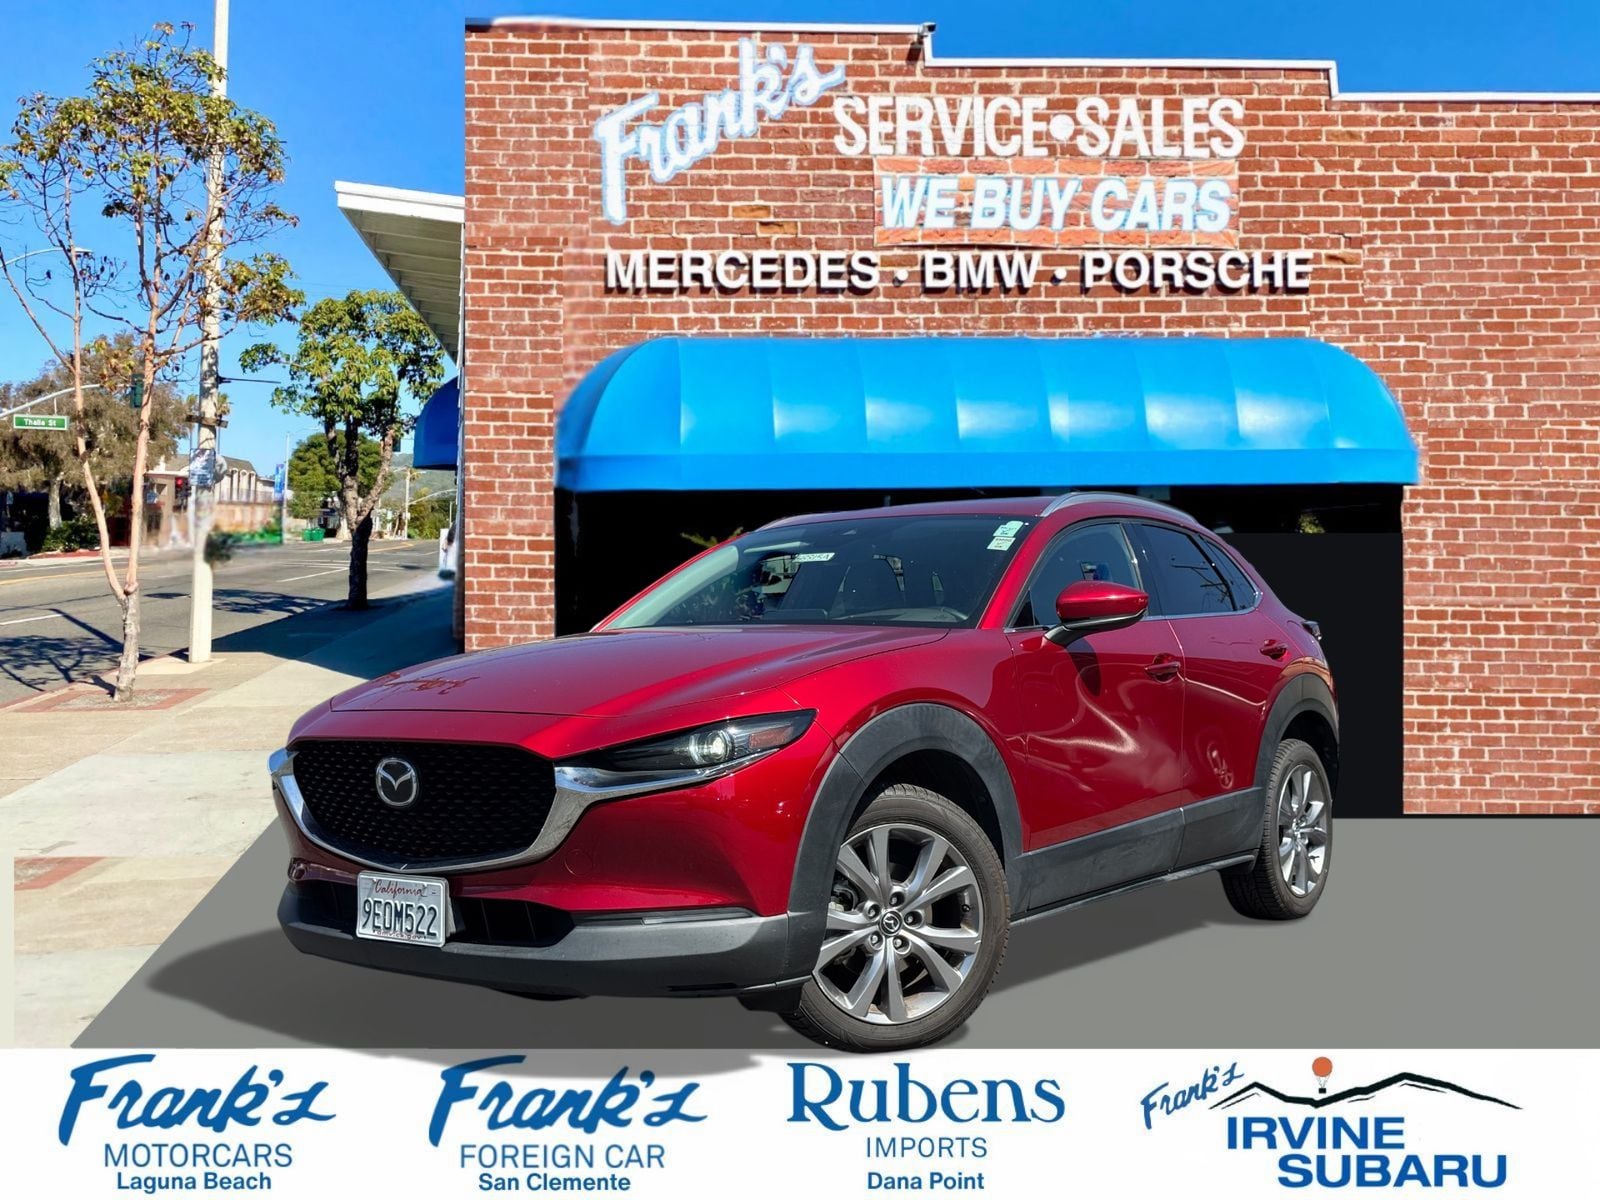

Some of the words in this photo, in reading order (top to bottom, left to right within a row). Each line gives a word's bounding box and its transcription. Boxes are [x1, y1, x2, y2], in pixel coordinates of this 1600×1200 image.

[594, 37, 846, 226] Frank's
[833, 95, 1049, 157] SERVICE
[1075, 95, 1246, 157] SALES
[881, 174, 960, 231] WE
[969, 176, 1081, 231] BUY
[1090, 177, 1233, 233] CARS
[606, 250, 880, 291] MERCEDES
[924, 250, 1041, 291] BMW
[1083, 250, 1313, 291] PORSCHE
[48, 419, 57, 427] St
[374, 881, 425, 899] California
